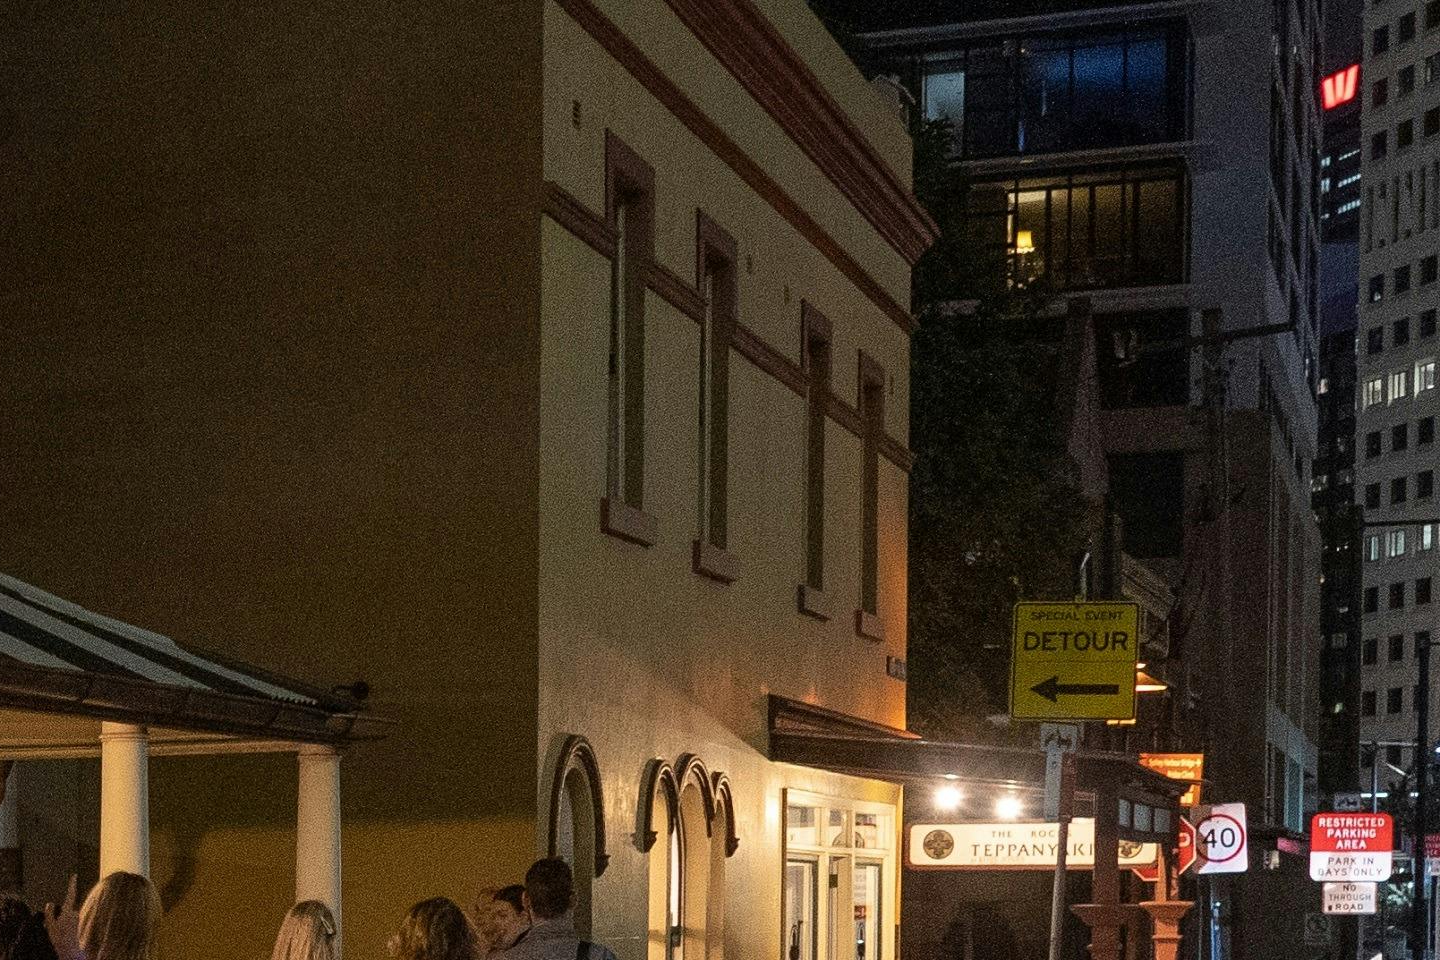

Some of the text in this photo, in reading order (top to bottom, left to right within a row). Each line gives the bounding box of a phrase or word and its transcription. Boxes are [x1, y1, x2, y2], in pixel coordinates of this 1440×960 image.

[1031, 610, 1124, 621] SPECIAL EVENT
[1023, 631, 1129, 651] DETOUR
[1319, 818, 1385, 827] RESTRICTED
[992, 830, 1073, 838] THE ROCS
[1203, 827, 1236, 848] 40
[1327, 829, 1376, 838] PARKING
[1336, 840, 1367, 849] AREA
[972, 843, 1094, 857] TEPPANYKI
[1328, 856, 1375, 865] PARK IN
[1354, 867, 1382, 876] ONLY
[1342, 884, 1357, 892] NO
[1328, 893, 1372, 901] THROUGH
[1334, 903, 1364, 911] ROAD
